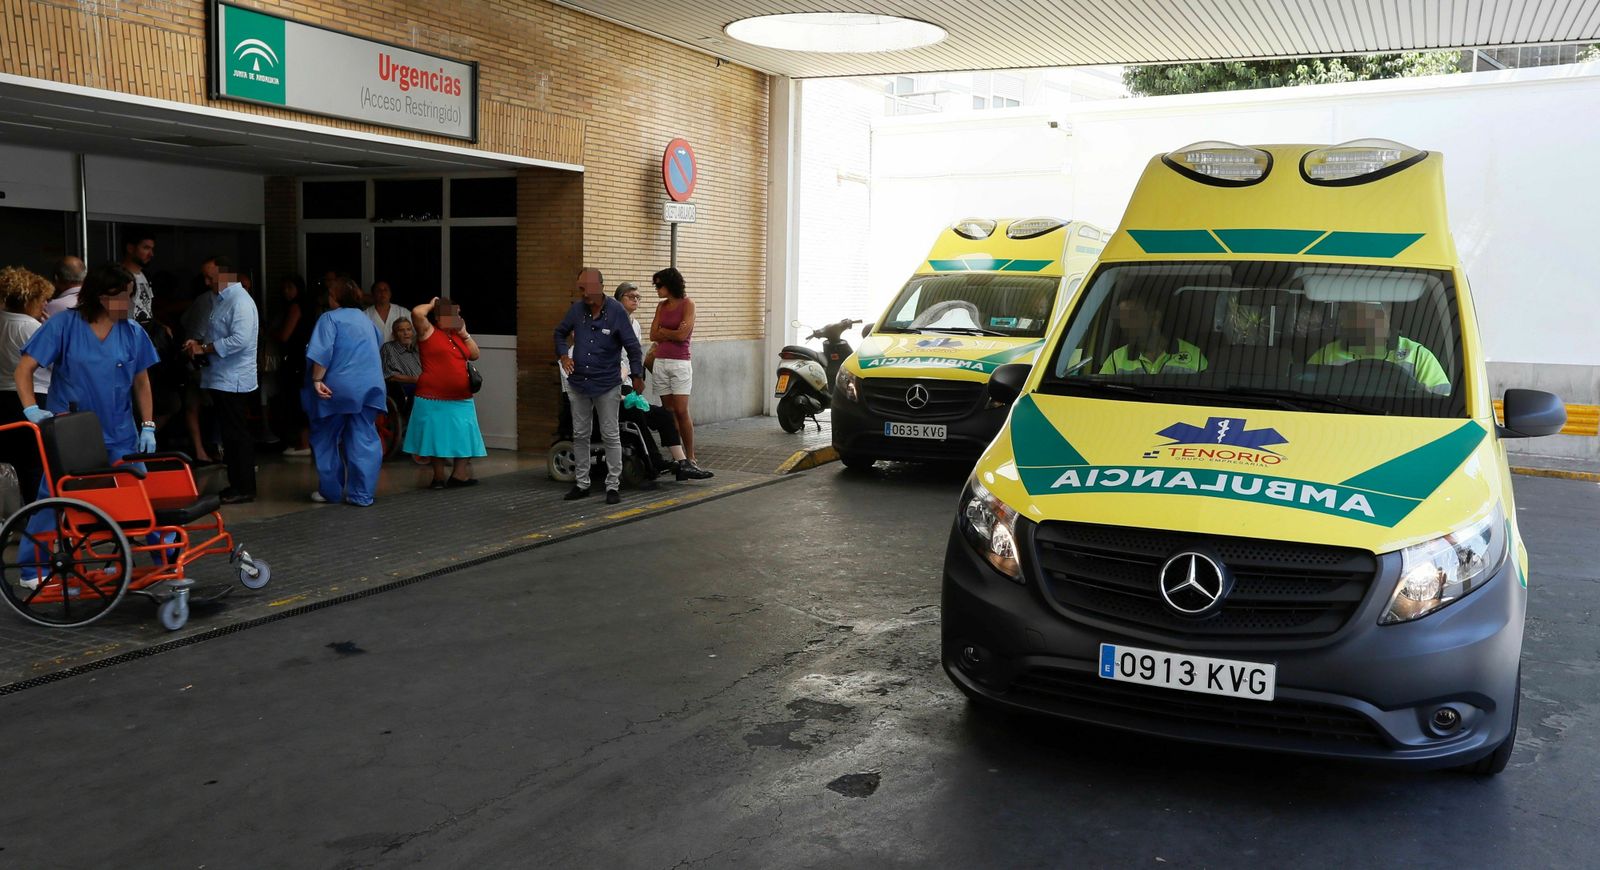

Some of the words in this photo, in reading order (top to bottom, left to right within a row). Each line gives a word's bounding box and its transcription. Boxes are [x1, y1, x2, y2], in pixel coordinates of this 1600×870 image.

[233, 69, 248, 79] JUNTA
[378, 52, 461, 97] Urgencias
[360, 86, 401, 113] (Acceso
[405, 95, 462, 127] Restringido)
[892, 424, 919, 437] 0635
[923, 426, 945, 438] KVG
[1208, 458, 1270, 468] EMPRESARIAL
[1104, 664, 1111, 672] E
[1120, 652, 1195, 686] 0913
[1207, 663, 1266, 695] KVG
